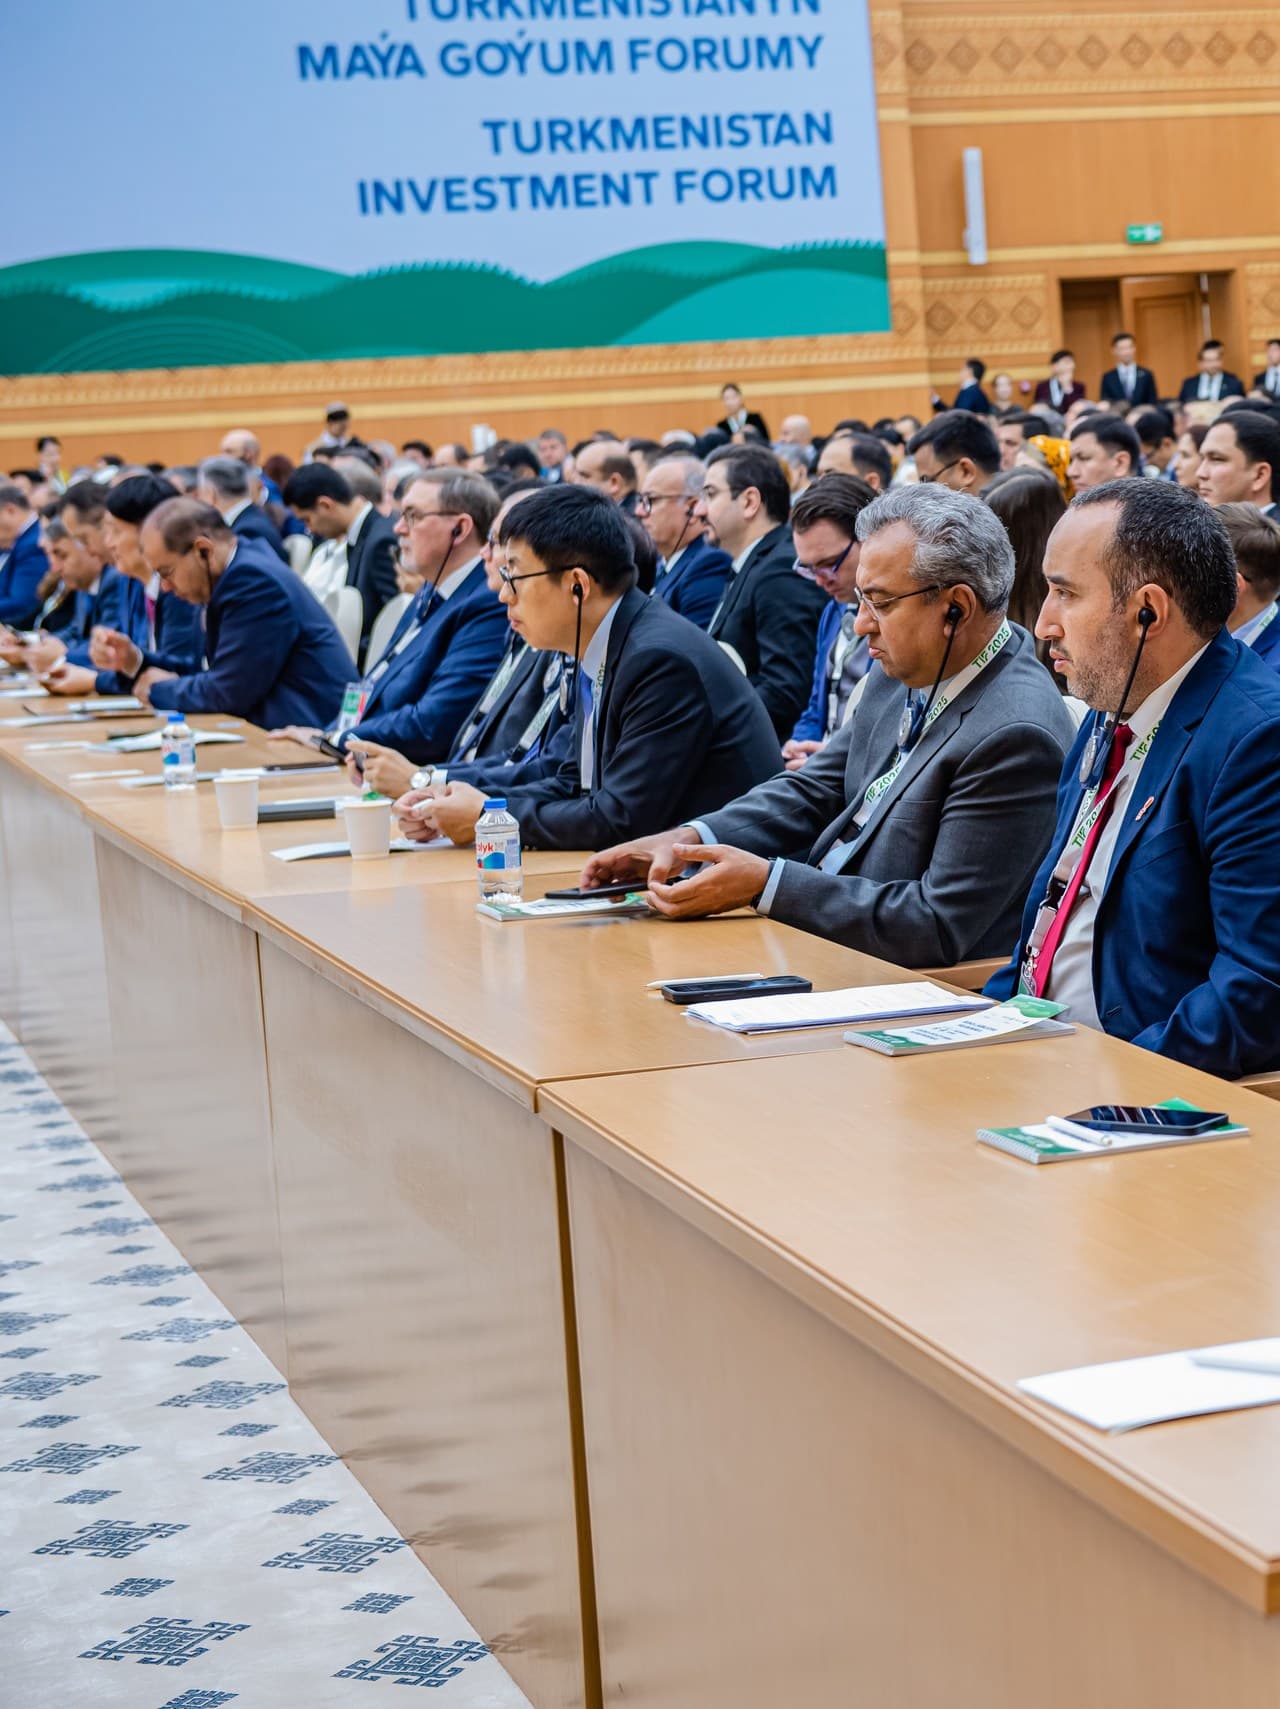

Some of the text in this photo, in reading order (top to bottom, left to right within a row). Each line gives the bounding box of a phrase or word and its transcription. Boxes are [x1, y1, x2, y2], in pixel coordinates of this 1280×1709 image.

[296, 30, 823, 81] MAÝA GOÝUM FORUMY
[481, 112, 832, 155] TURKMENISTAN
[357, 165, 837, 216] INVESTMENT FORUM
[972, 627, 1010, 668] TIF 2025
